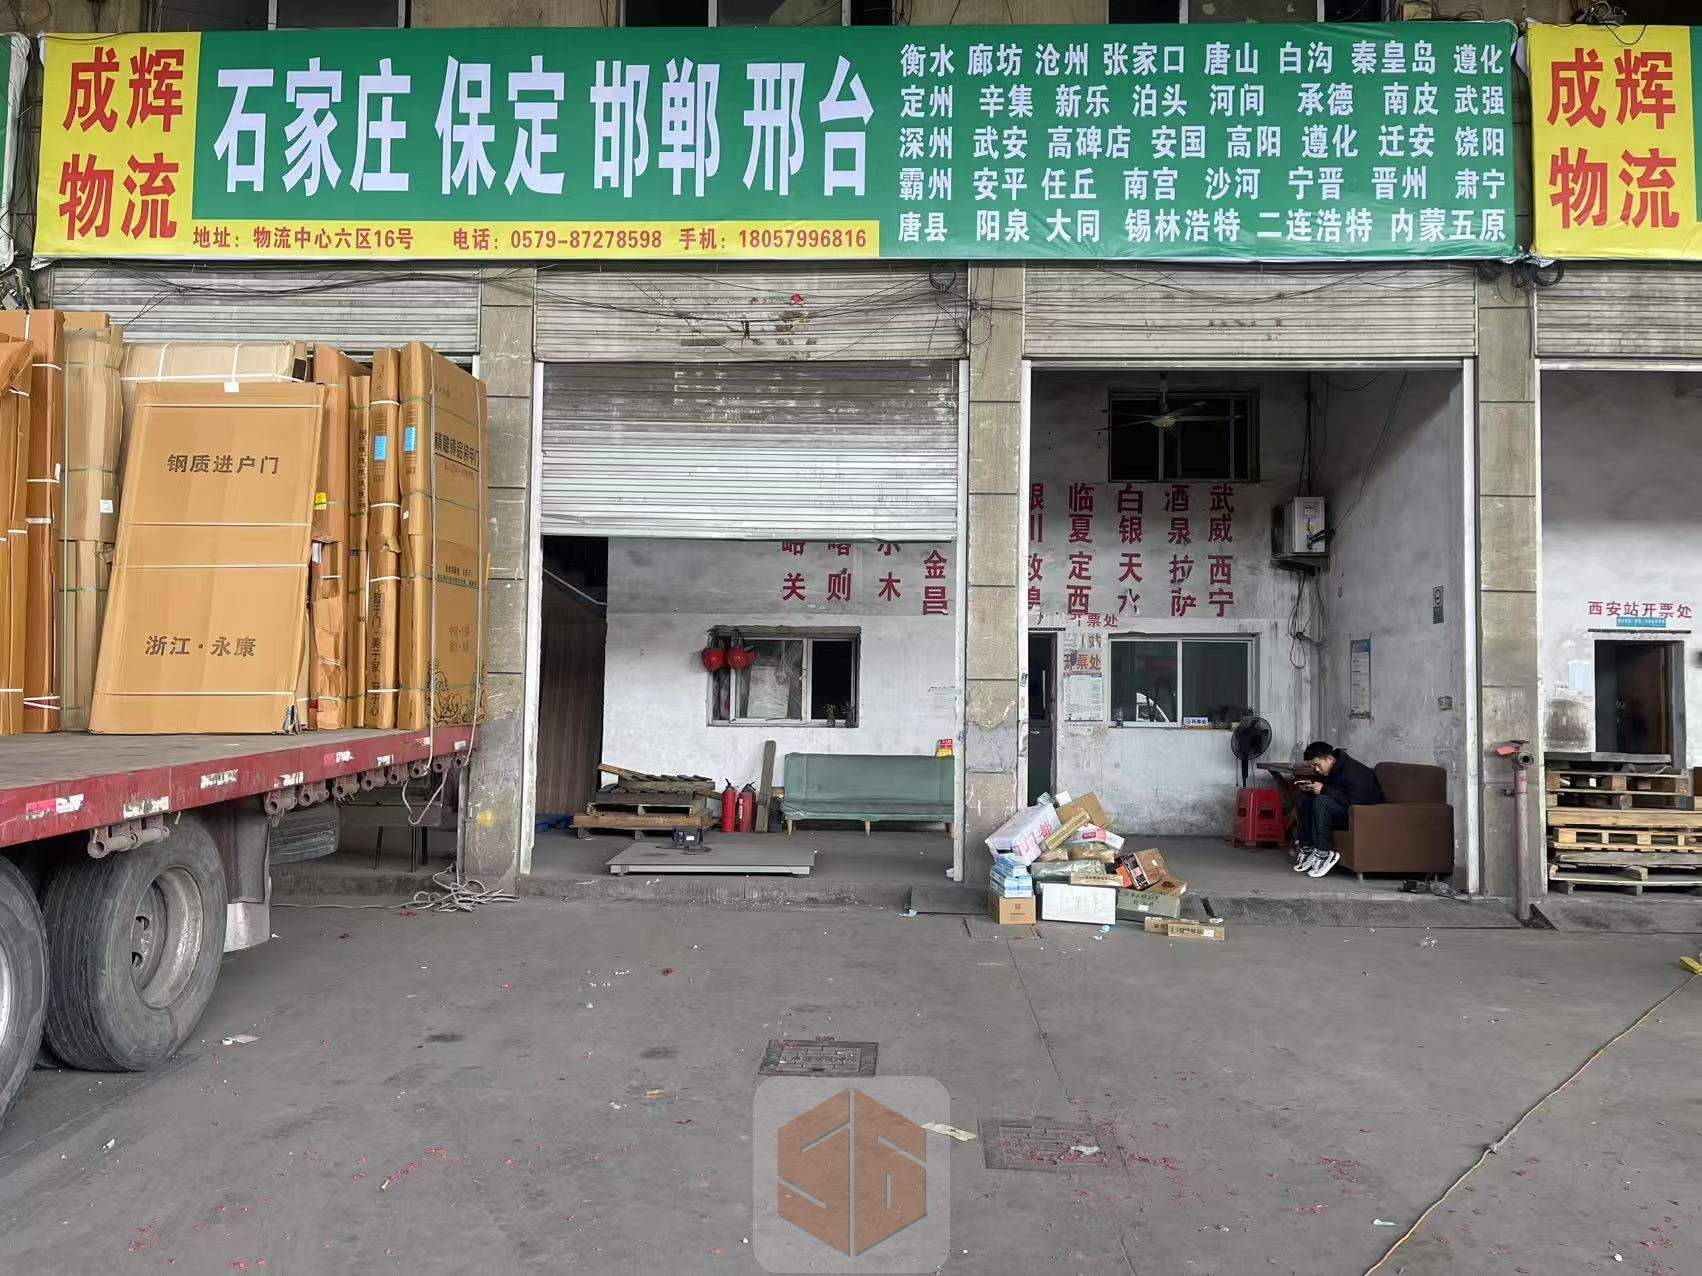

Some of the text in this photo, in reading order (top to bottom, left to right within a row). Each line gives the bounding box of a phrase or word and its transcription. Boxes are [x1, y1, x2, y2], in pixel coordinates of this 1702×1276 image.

[901, 40, 1503, 76] 衡水 廊坊 沧州 张家口 唐山 白沟 秦皇岛 遵化
[64, 48, 185, 132] 成辉
[901, 82, 1504, 117] 定州 辛集 新乐 泊头 河间 承德 南皮 武强
[1548, 49, 1676, 129] 成辉
[214, 56, 874, 197] 石家庄 保定 邯郸 邢台
[900, 124, 1504, 159] 深州 武安 高碑店 安国 高阳 遵化 迁安 饶阳
[59, 153, 177, 240] 物流
[900, 166, 1505, 200] 霸州 安平 任丘 南宫 沙河 宁晋 晋州 肃宁
[1550, 148, 1680, 230] 物流
[898, 208, 1506, 244] 唐县 阳泉 大同 锡林浩特 二连浩特 内蒙五原
[167, 454, 279, 474] 钢质进户门
[1068, 483, 1094, 543] 临夏
[1117, 484, 1143, 544] 白银
[1164, 485, 1191, 544] 酒泉
[1208, 484, 1234, 544] 武威
[923, 550, 948, 615] 金昌
[1067, 551, 1092, 615] 定西
[1118, 553, 1142, 614] 天水
[1169, 555, 1197, 617] 拉萨
[1208, 555, 1234, 617] 西宁
[1588, 601, 1692, 618] 西安站开票处
